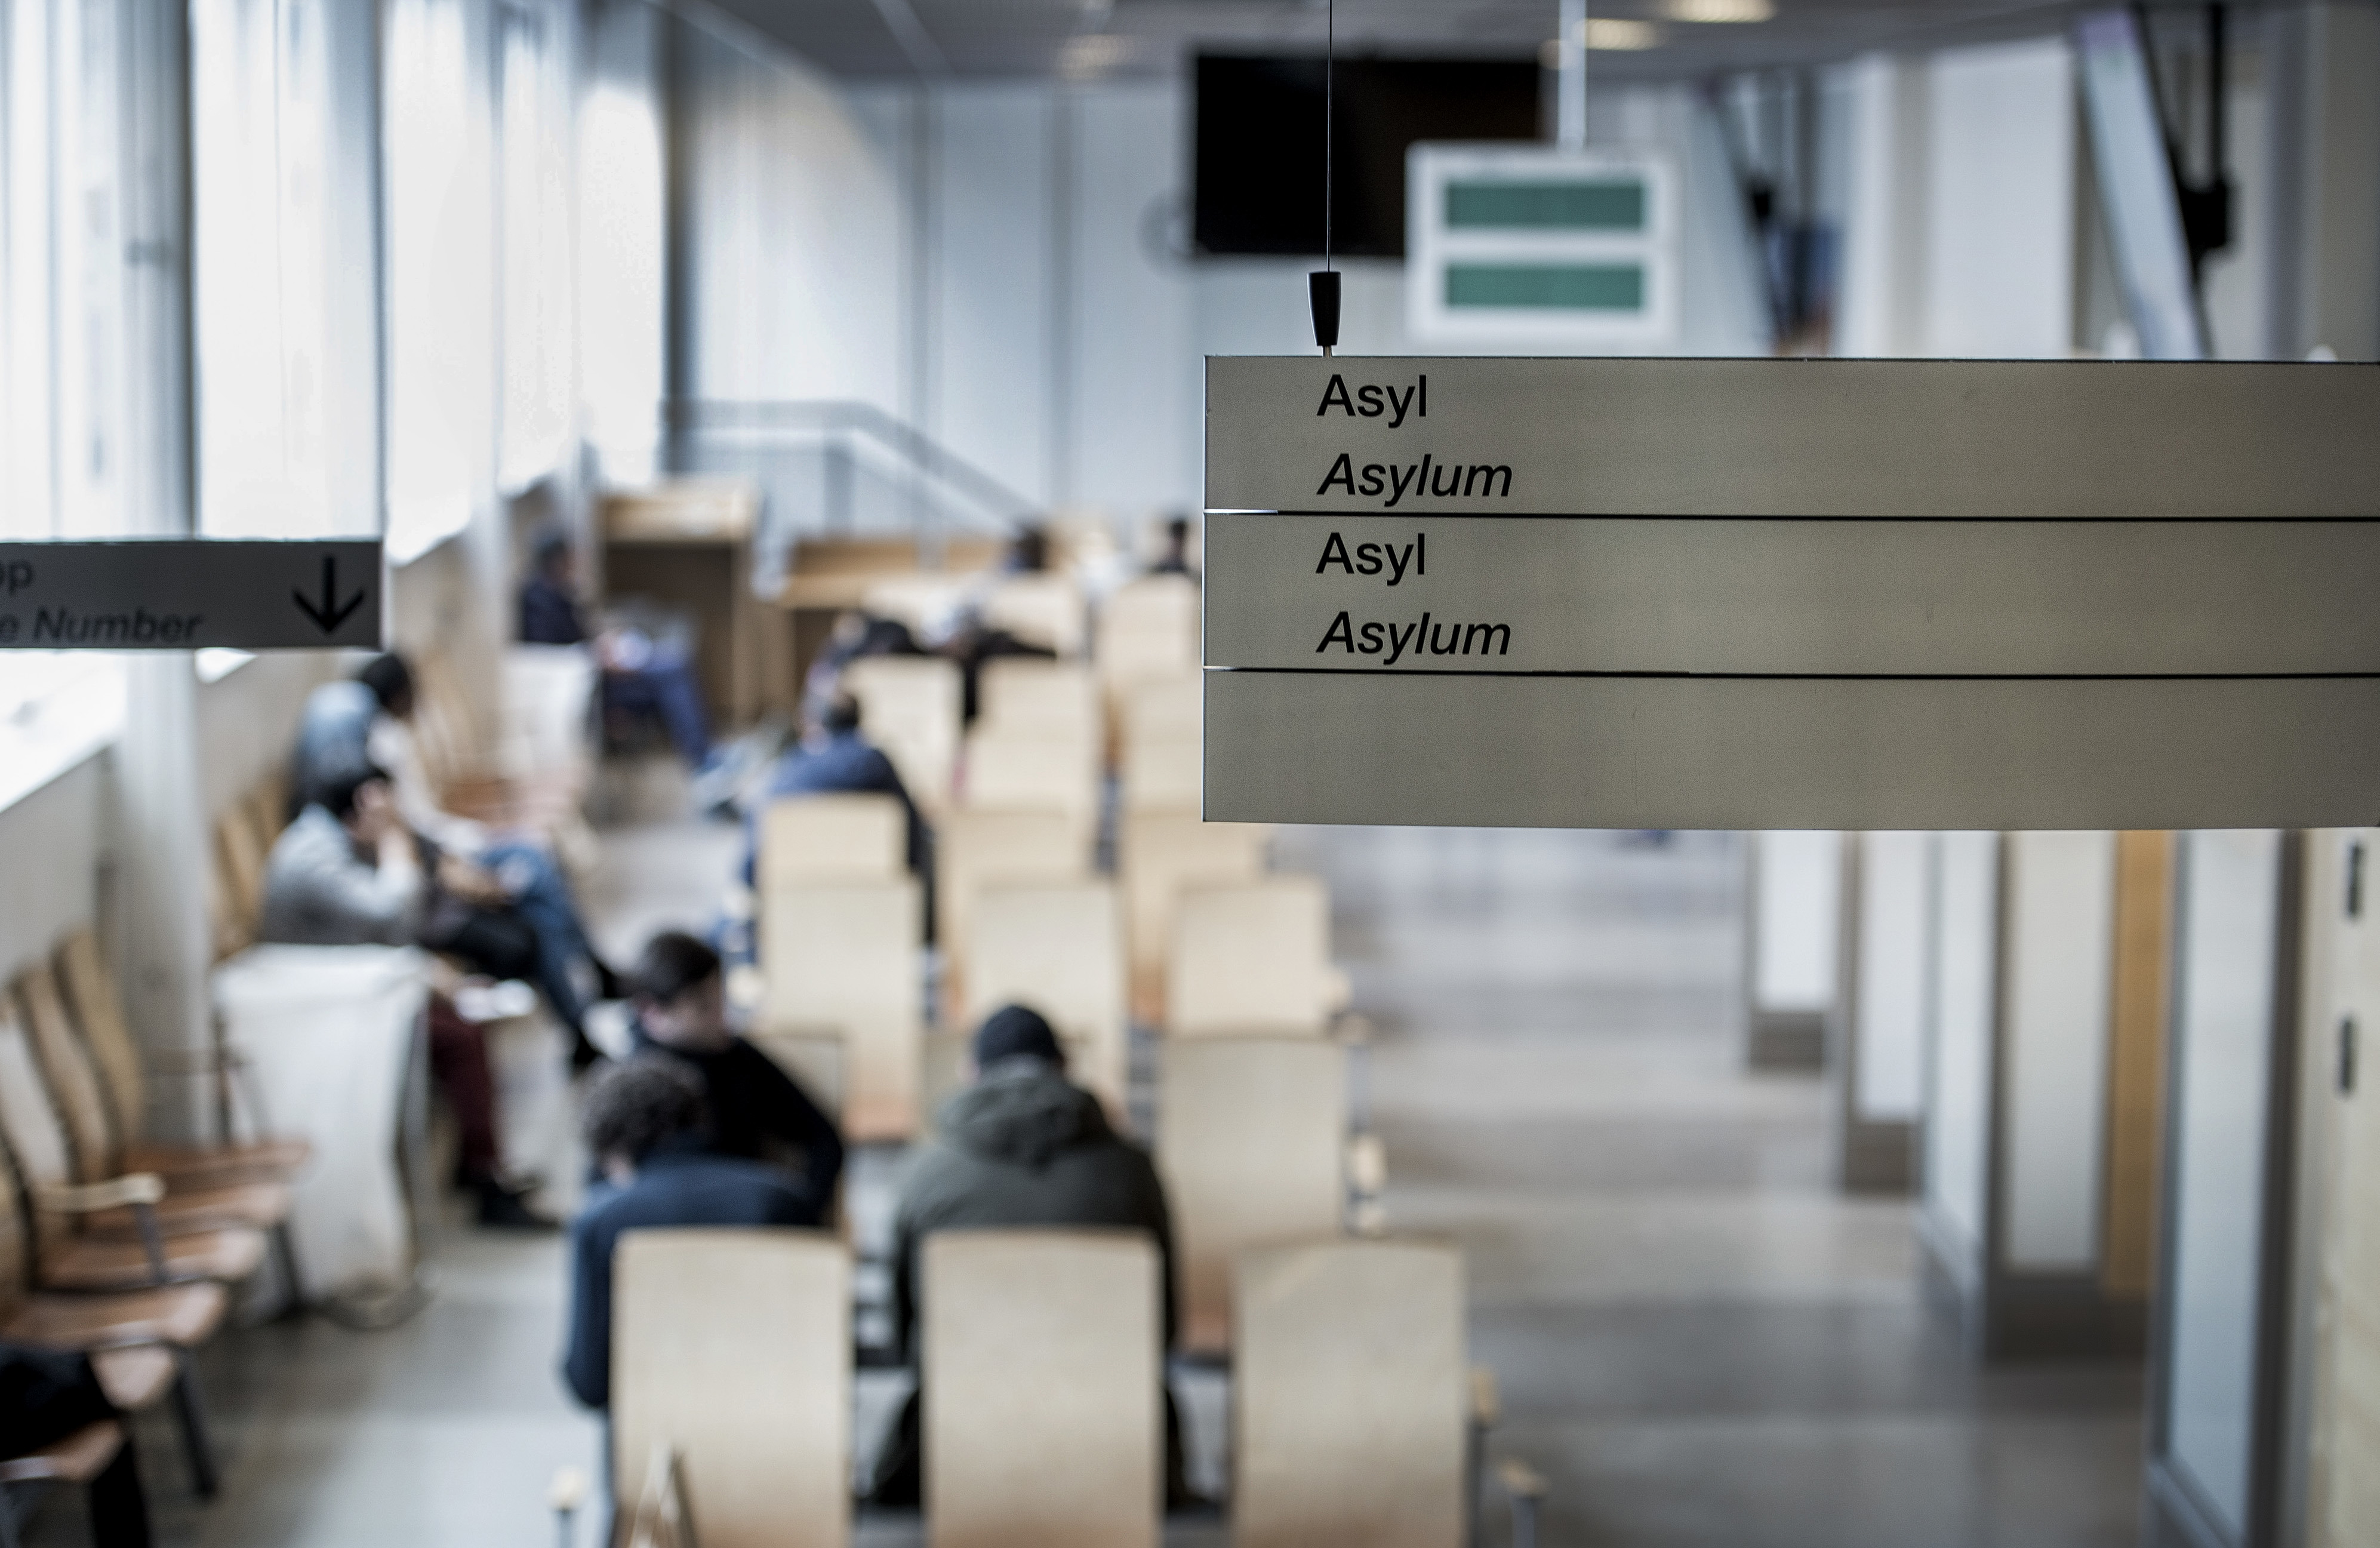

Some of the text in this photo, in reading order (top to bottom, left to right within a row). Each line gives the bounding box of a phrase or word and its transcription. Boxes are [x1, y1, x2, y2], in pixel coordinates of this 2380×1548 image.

[1316, 374, 1427, 428] Asyl
[1316, 453, 1513, 507] Asylum
[1315, 531, 1425, 586] Asyl
[33, 605, 202, 642] Number
[1315, 611, 1511, 665] Asylum
